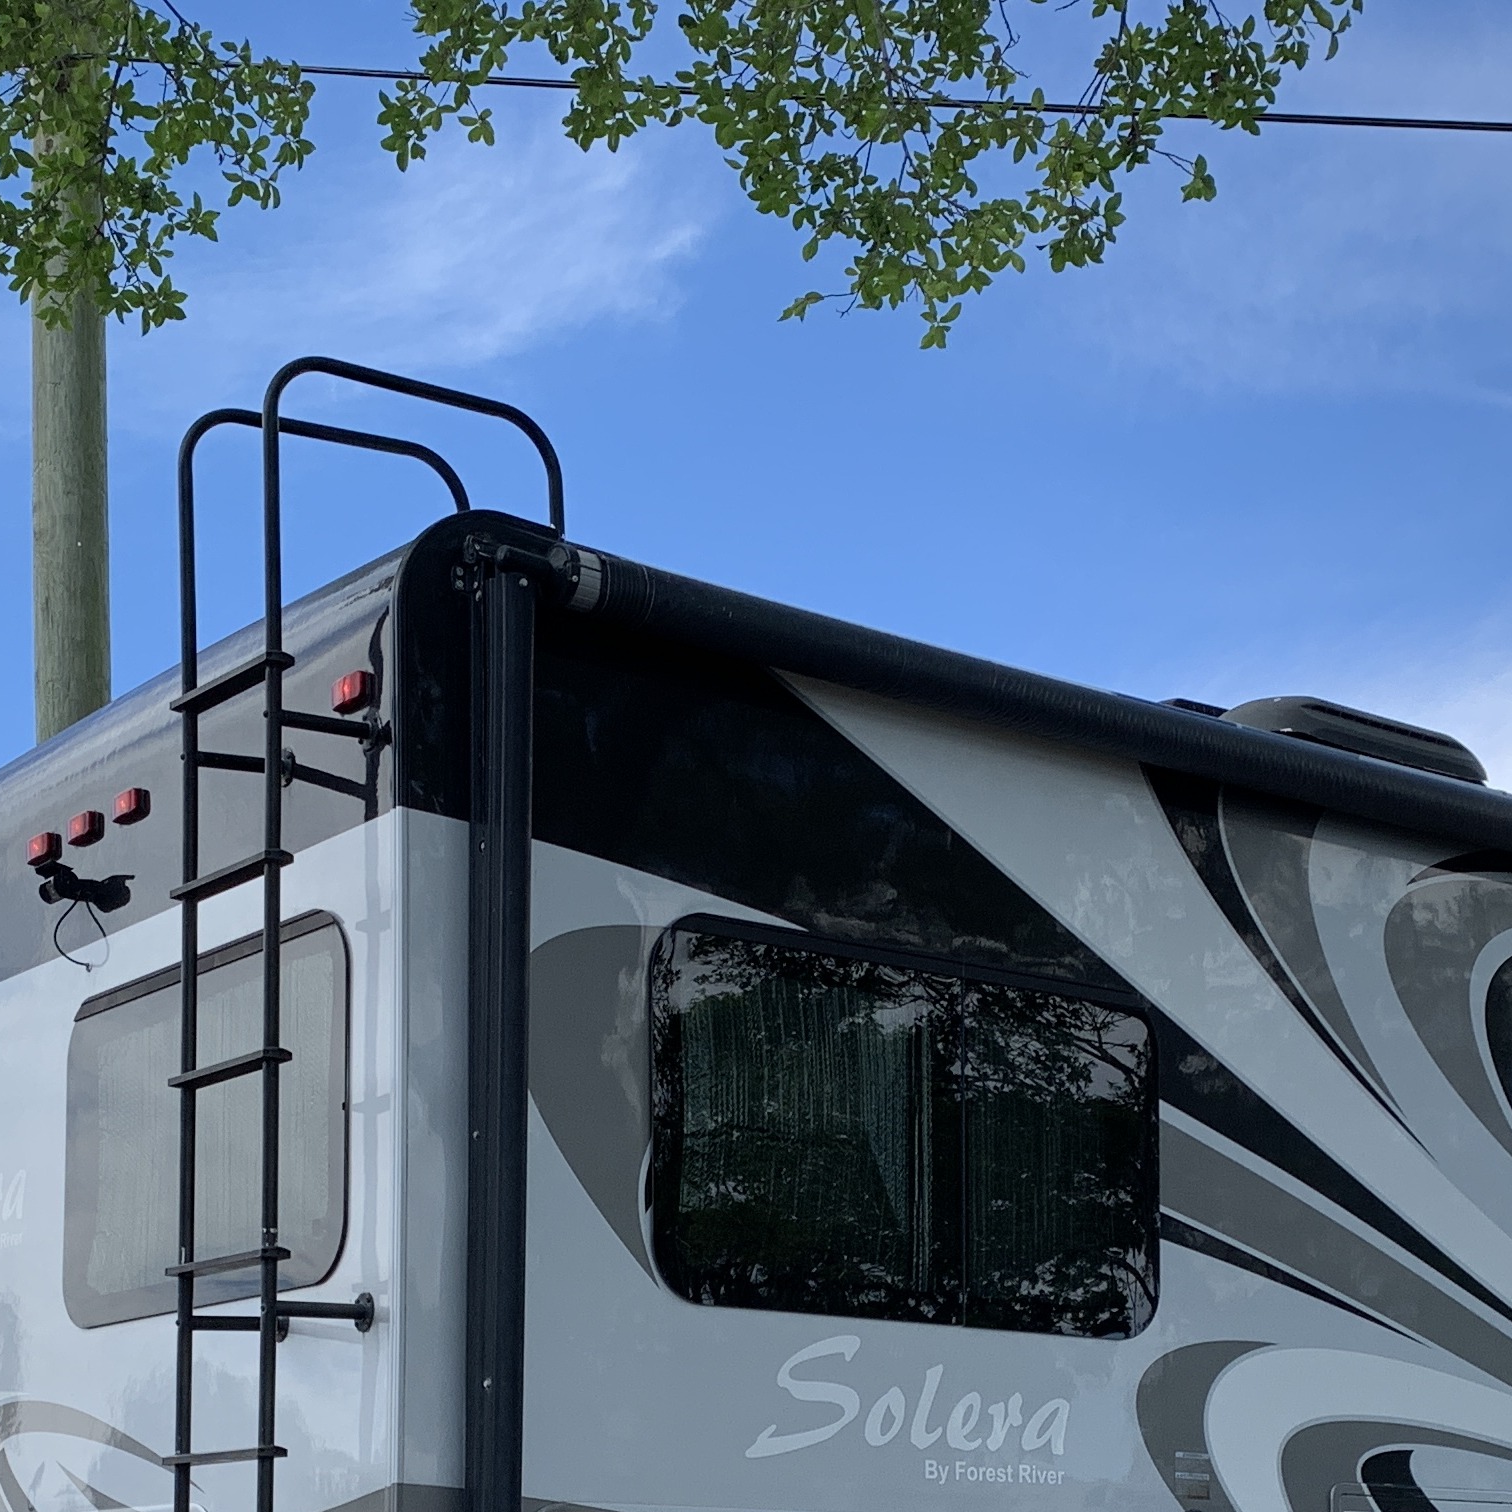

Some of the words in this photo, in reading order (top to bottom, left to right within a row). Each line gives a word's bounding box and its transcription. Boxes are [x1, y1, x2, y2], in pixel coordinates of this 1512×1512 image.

[745, 1335, 1070, 1458] Solera
[924, 1460, 949, 1485] By
[955, 1461, 1013, 1482] Forest
[1018, 1465, 1065, 1485] River
